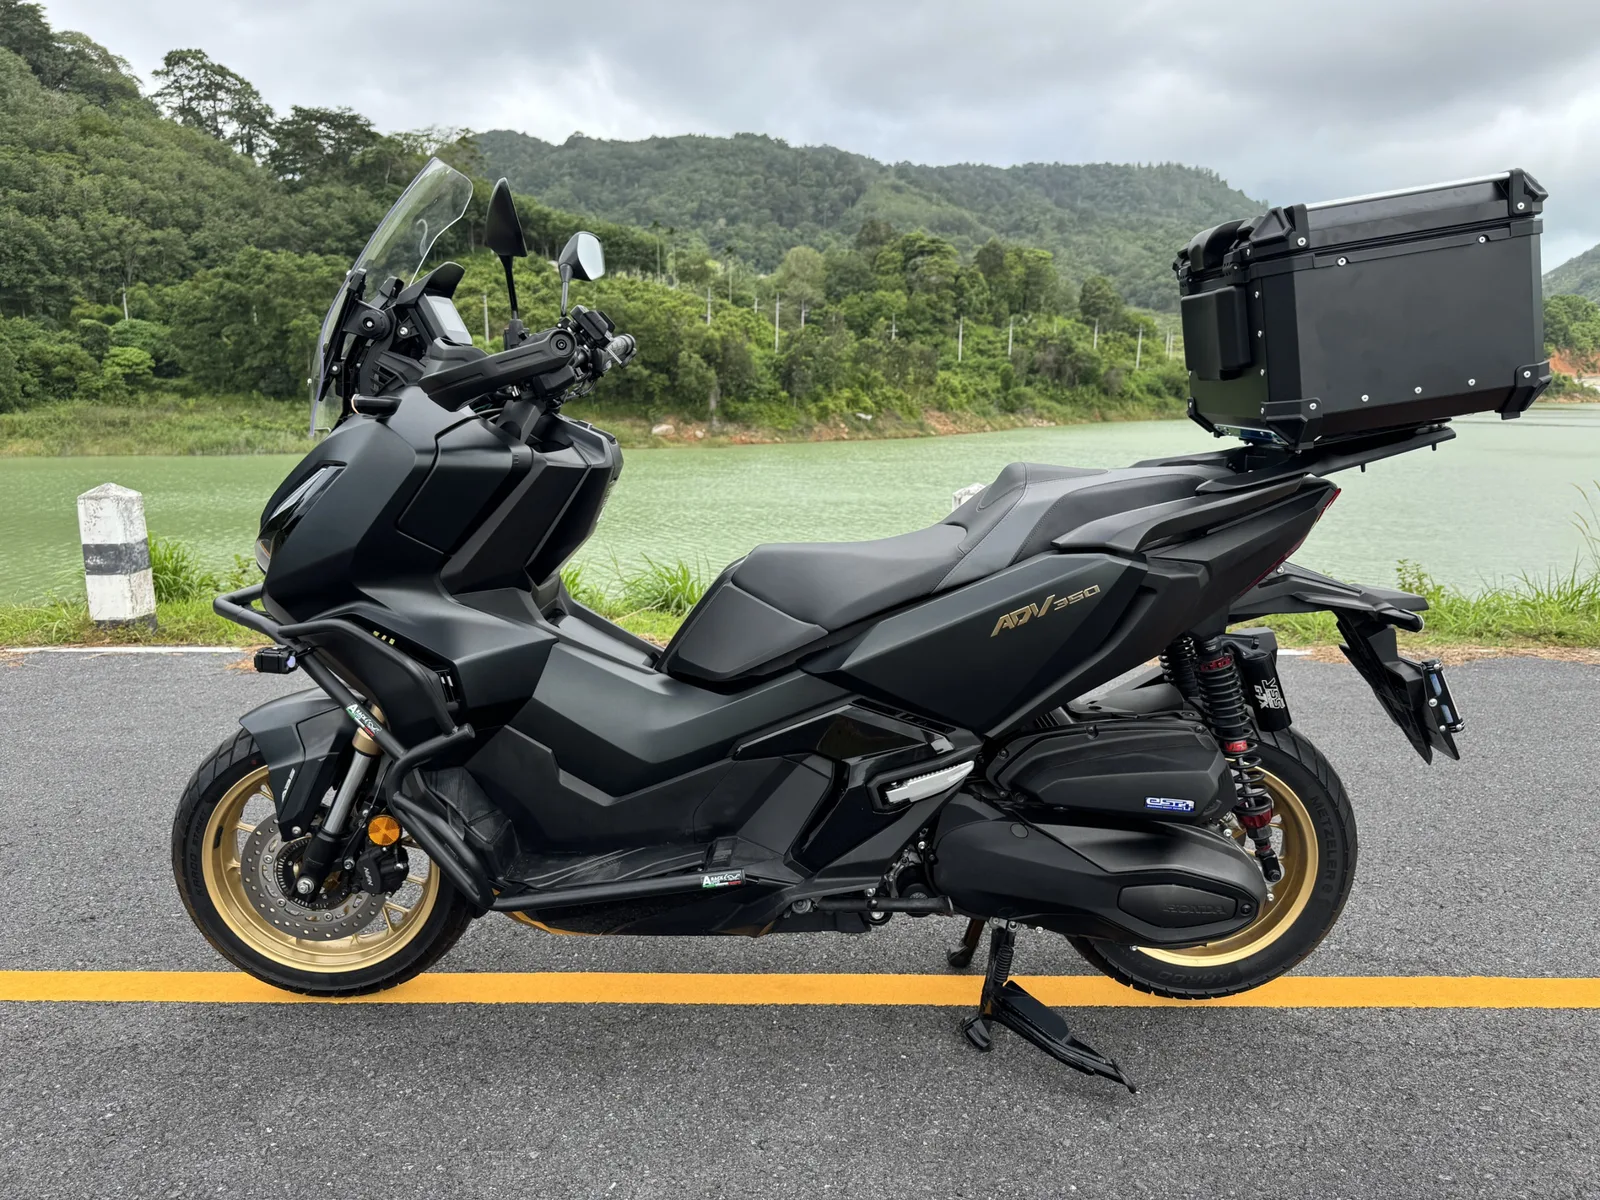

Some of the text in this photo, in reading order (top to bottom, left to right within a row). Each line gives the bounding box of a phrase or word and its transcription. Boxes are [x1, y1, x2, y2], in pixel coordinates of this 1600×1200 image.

[990, 584, 1101, 637] ADV 350
[1261, 677, 1286, 709] YSS
[1311, 796, 1338, 883] METZELER
[1163, 903, 1228, 915] HONDA
